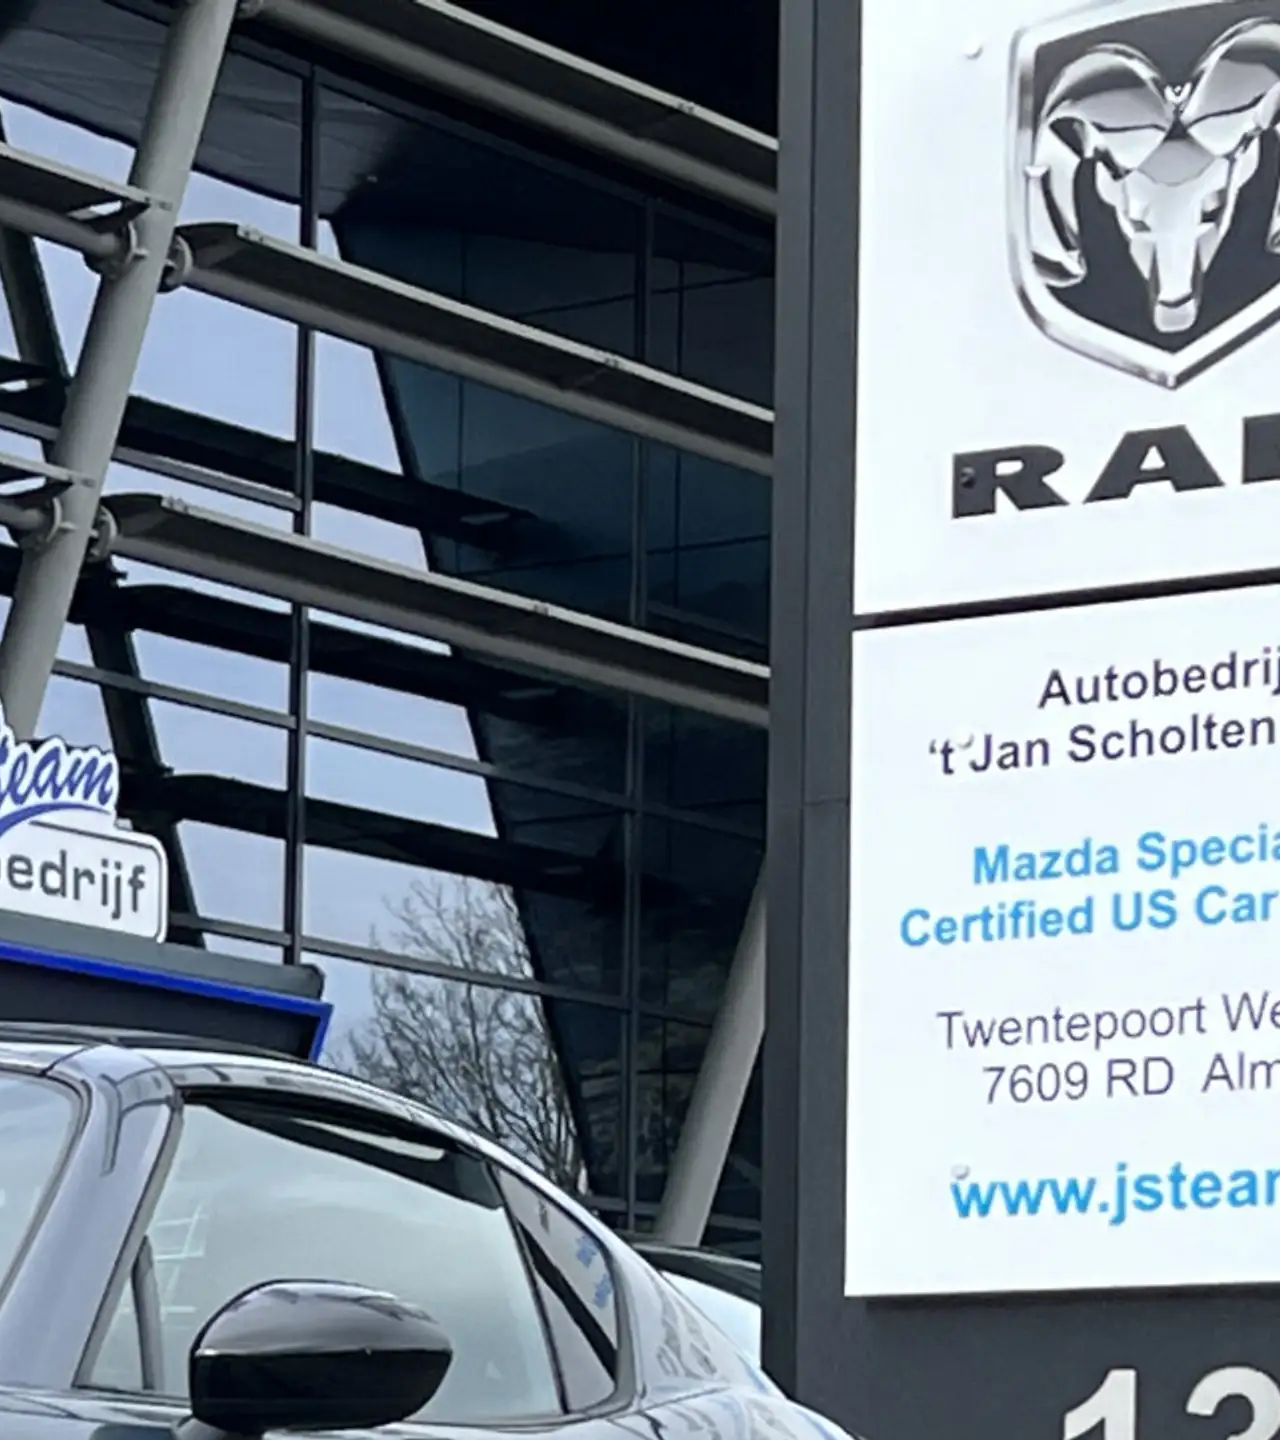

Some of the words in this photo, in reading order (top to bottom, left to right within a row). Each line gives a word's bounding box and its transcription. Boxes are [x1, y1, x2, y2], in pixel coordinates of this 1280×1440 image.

[968, 733, 1050, 772] Jan
[1068, 712, 1276, 763] Scholten
[972, 837, 1119, 885] Mazda
[899, 896, 1094, 948] Certified
[1112, 889, 1178, 931] US
[935, 996, 1207, 1050] Twentepoort
[982, 1061, 1089, 1104] 7609
[1106, 1056, 1174, 1098] RD
